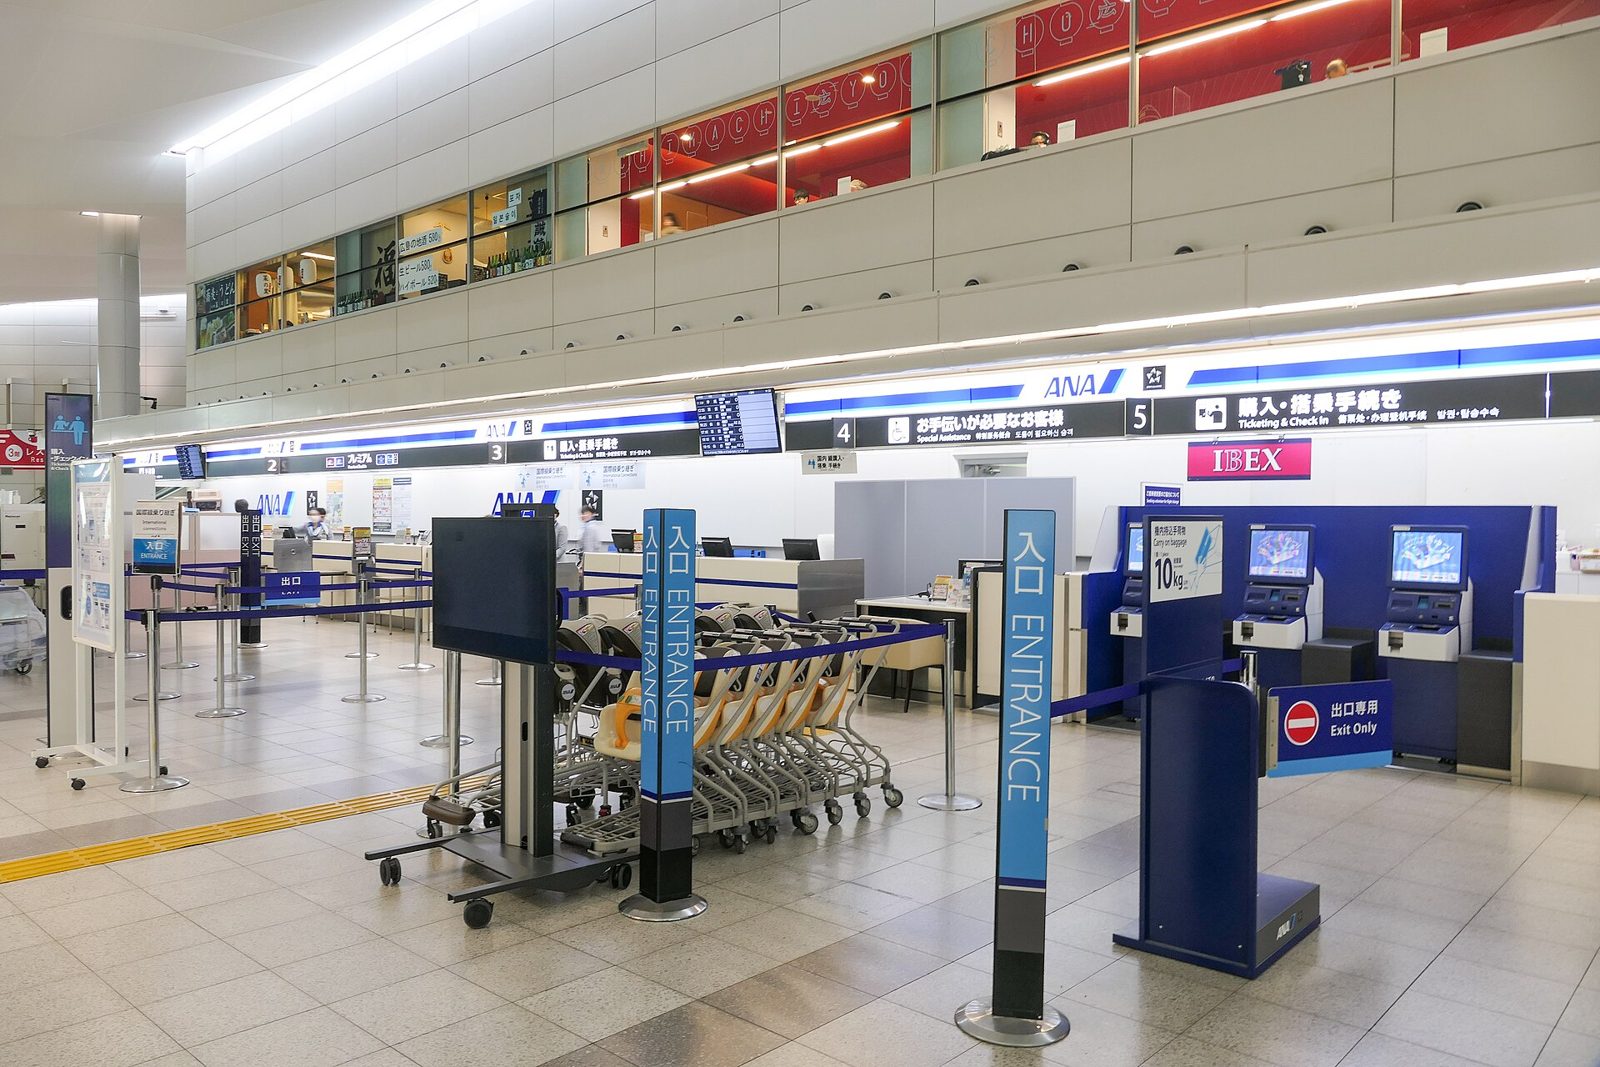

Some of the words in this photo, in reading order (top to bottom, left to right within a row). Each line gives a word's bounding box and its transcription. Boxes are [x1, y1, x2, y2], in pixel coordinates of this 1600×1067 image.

[1044, 374, 1095, 398] ANA
[1238, 389, 1402, 417] 購入・搭乗手続き
[916, 408, 1064, 433] お手伝いが必要なお客様
[1133, 404, 1147, 429] 5
[1238, 418, 1280, 429] Ticketing
[1281, 417, 1288, 427] &
[1289, 415, 1318, 427] Check
[837, 423, 851, 443] 4
[916, 434, 938, 444] Special
[939, 433, 972, 442] Assistance
[491, 444, 503, 461] 3
[1212, 447, 1283, 473] IBEX
[267, 459, 278, 472] 2
[257, 494, 280, 515] ANA
[242, 514, 249, 532] 出口
[252, 514, 260, 532] 出口
[145, 541, 164, 550] 入口
[241, 536, 249, 557] EXIT
[252, 536, 260, 557] EXIT
[646, 526, 658, 574] 入口
[668, 526, 690, 575] 入口
[1153, 538, 1164, 548] Carry
[140, 552, 168, 560] ENTRANCE
[1013, 532, 1046, 595] 入口
[281, 576, 301, 586] 出口
[1154, 557, 1173, 590] 10
[1173, 570, 1184, 591] kg
[643, 588, 658, 734] ENTRANCE
[666, 588, 690, 735] ENTRANCE
[1008, 614, 1045, 803] ENTRANCE
[1330, 700, 1379, 718] 出口専用
[1330, 723, 1351, 737] Exit
[1353, 721, 1378, 736] Only
